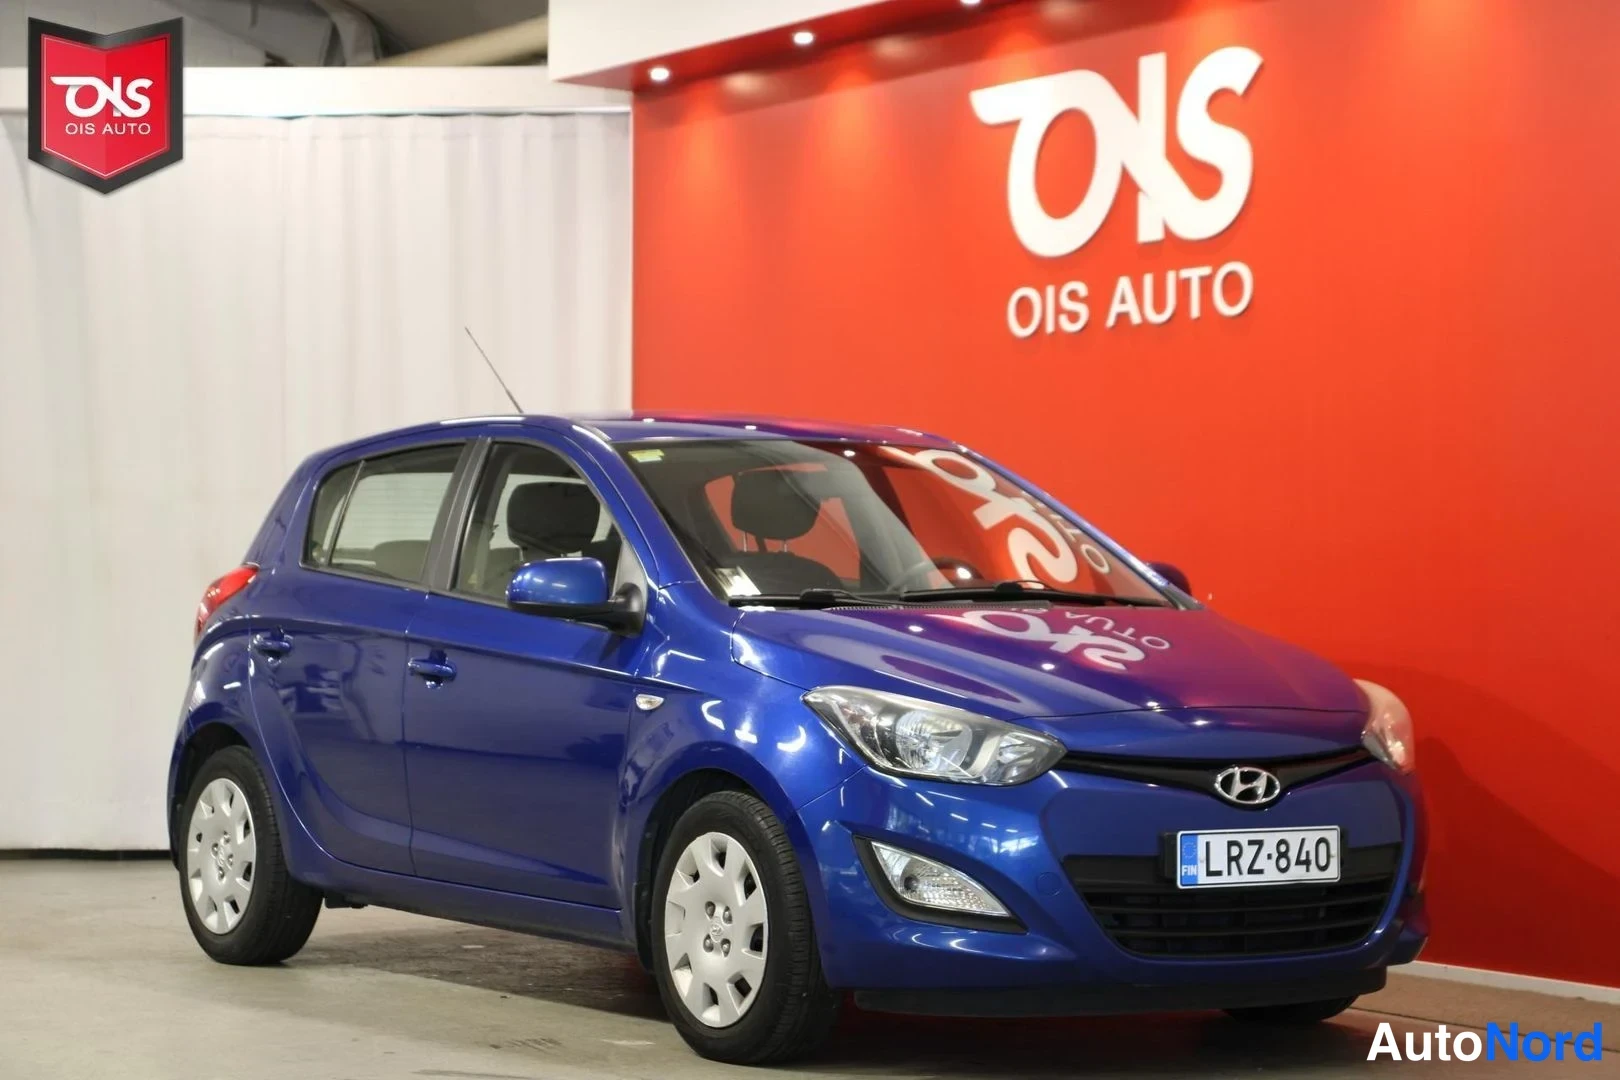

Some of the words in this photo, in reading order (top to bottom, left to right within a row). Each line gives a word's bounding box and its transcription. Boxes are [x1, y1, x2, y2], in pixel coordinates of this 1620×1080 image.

[969, 46, 1263, 257] OIS
[1007, 281, 1089, 338] OIS
[1106, 261, 1253, 328] AUTO
[1181, 865, 1197, 877] FIN
